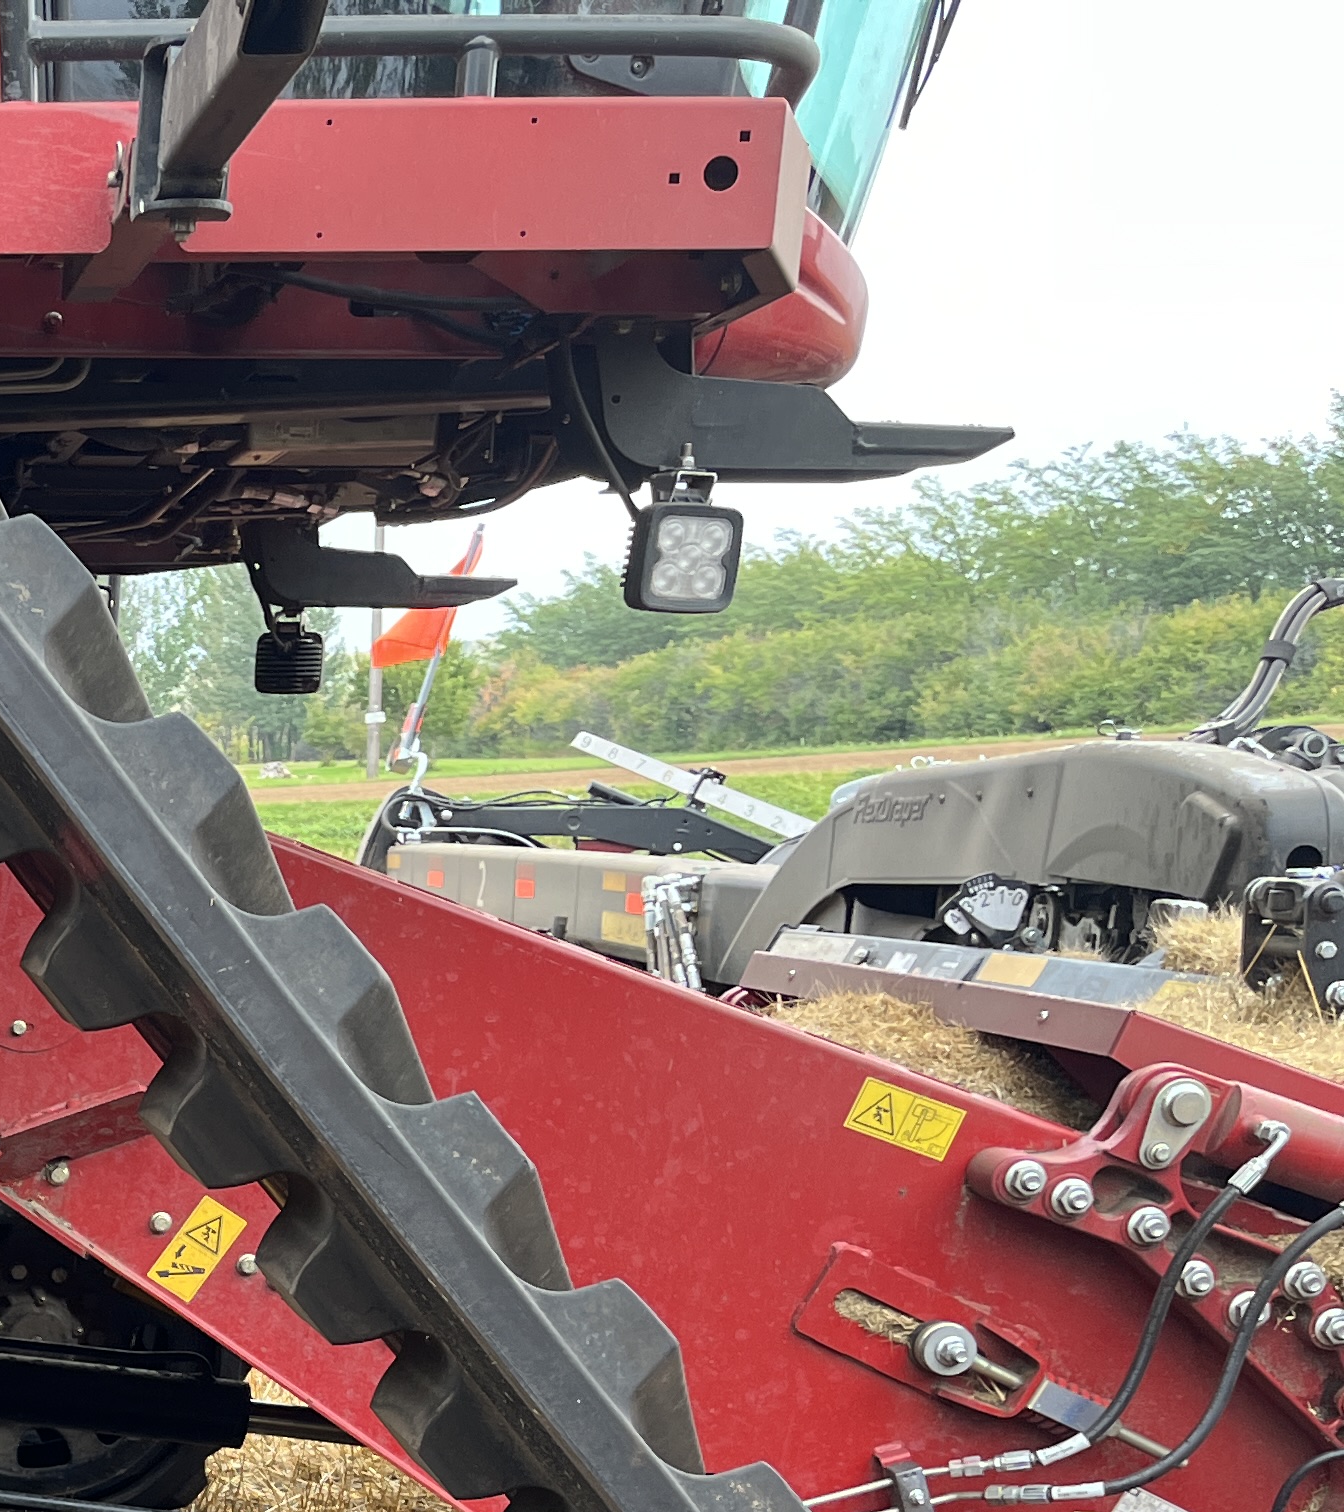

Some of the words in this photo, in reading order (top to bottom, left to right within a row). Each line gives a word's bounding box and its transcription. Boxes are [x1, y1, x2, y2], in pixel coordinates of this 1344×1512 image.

[580, 736, 592, 748] 9
[608, 747, 619, 760] 8
[635, 758, 647, 770] 7
[662, 769, 674, 783] 6
[718, 793, 728, 805] 4
[744, 804, 755, 818] 3
[771, 815, 783, 829] 2
[950, 912, 963, 924] 4
[962, 900, 975, 914] 3
[979, 891, 992, 908] 2
[998, 889, 1006, 904] 1
[1012, 891, 1024, 906] 0
